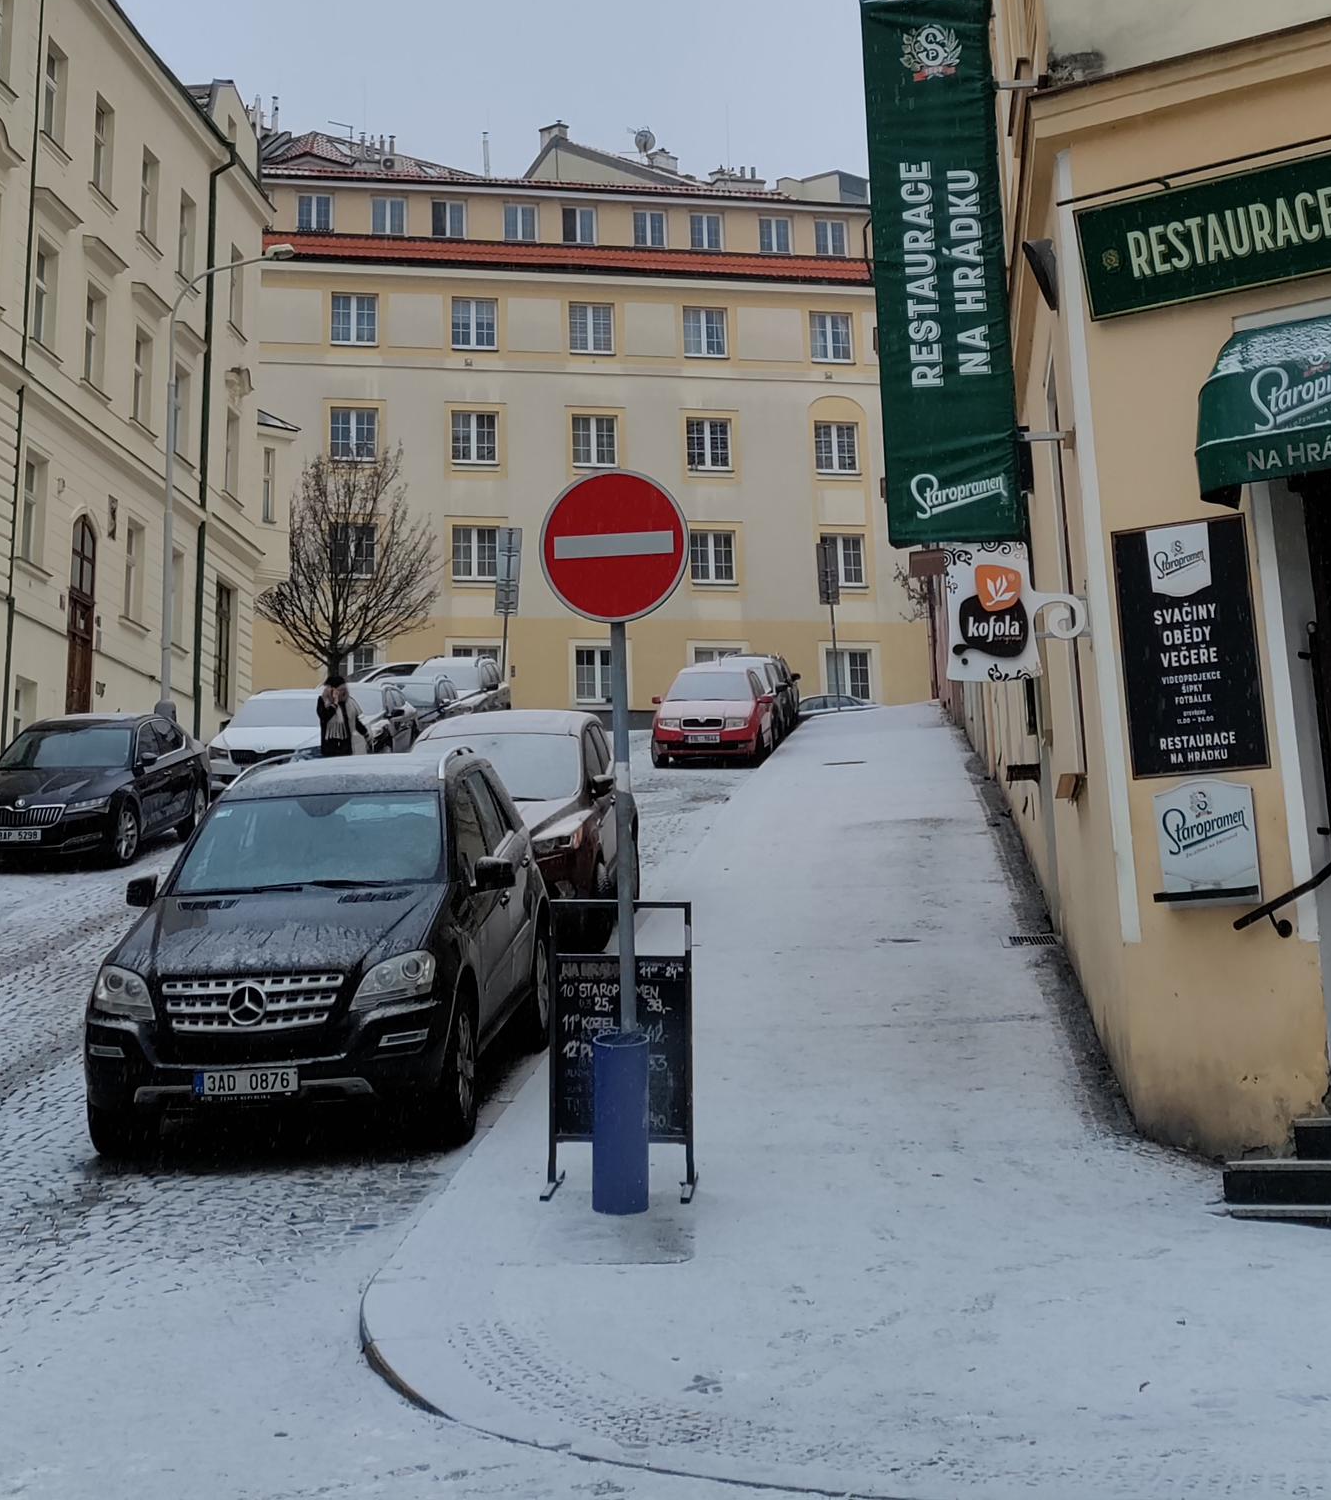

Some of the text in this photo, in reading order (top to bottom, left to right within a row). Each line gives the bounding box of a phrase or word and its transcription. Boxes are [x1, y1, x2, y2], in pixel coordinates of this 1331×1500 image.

[900, 160, 945, 388] RESTAURACE
[942, 169, 992, 376] NA HRÁDKU
[1246, 449, 1282, 472] NA
[910, 473, 1008, 520] Staropramen
[1153, 549, 1206, 580] Staropramen
[1153, 602, 1217, 625] SVAČINY
[968, 615, 1020, 643] kofola
[1163, 624, 1212, 646] OBĚDY
[1160, 644, 1218, 668] VEČEŘE
[1161, 670, 1221, 685] VIDEOPROJEKCE
[1181, 684, 1203, 693] ŠIPKY
[1159, 731, 1236, 750] RESTAURACE
[1170, 748, 1228, 764] NA HRÁDKU
[1162, 808, 1249, 855] Staropramen
[582, 1016, 619, 1030] KOZEL
[208, 1074, 236, 1092] 3AD
[249, 1072, 289, 1090] 0876
